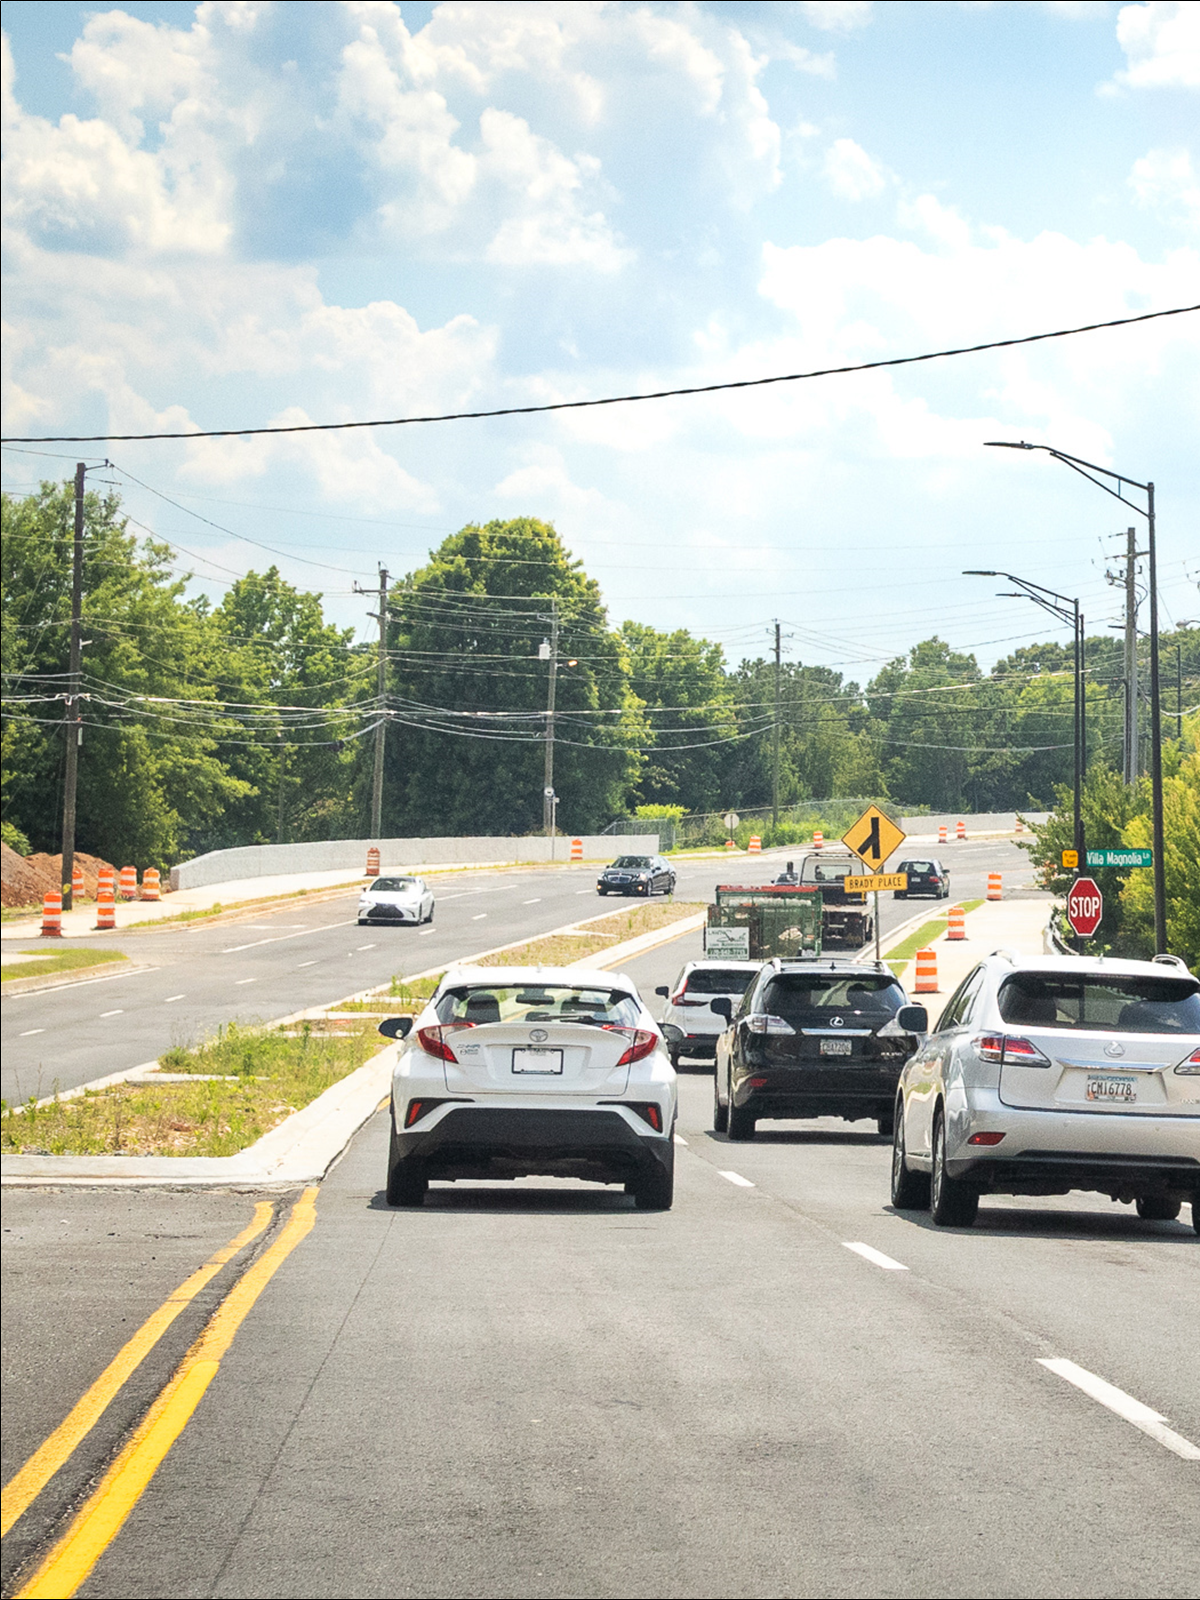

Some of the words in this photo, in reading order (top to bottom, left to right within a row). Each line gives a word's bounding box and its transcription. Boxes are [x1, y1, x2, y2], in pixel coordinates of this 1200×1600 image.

[1087, 852, 1104, 865] Villa
[1107, 852, 1142, 866] Magnolia
[850, 879, 874, 889] BRADY
[878, 877, 901, 887] PLACE
[1070, 896, 1100, 918] STOP
